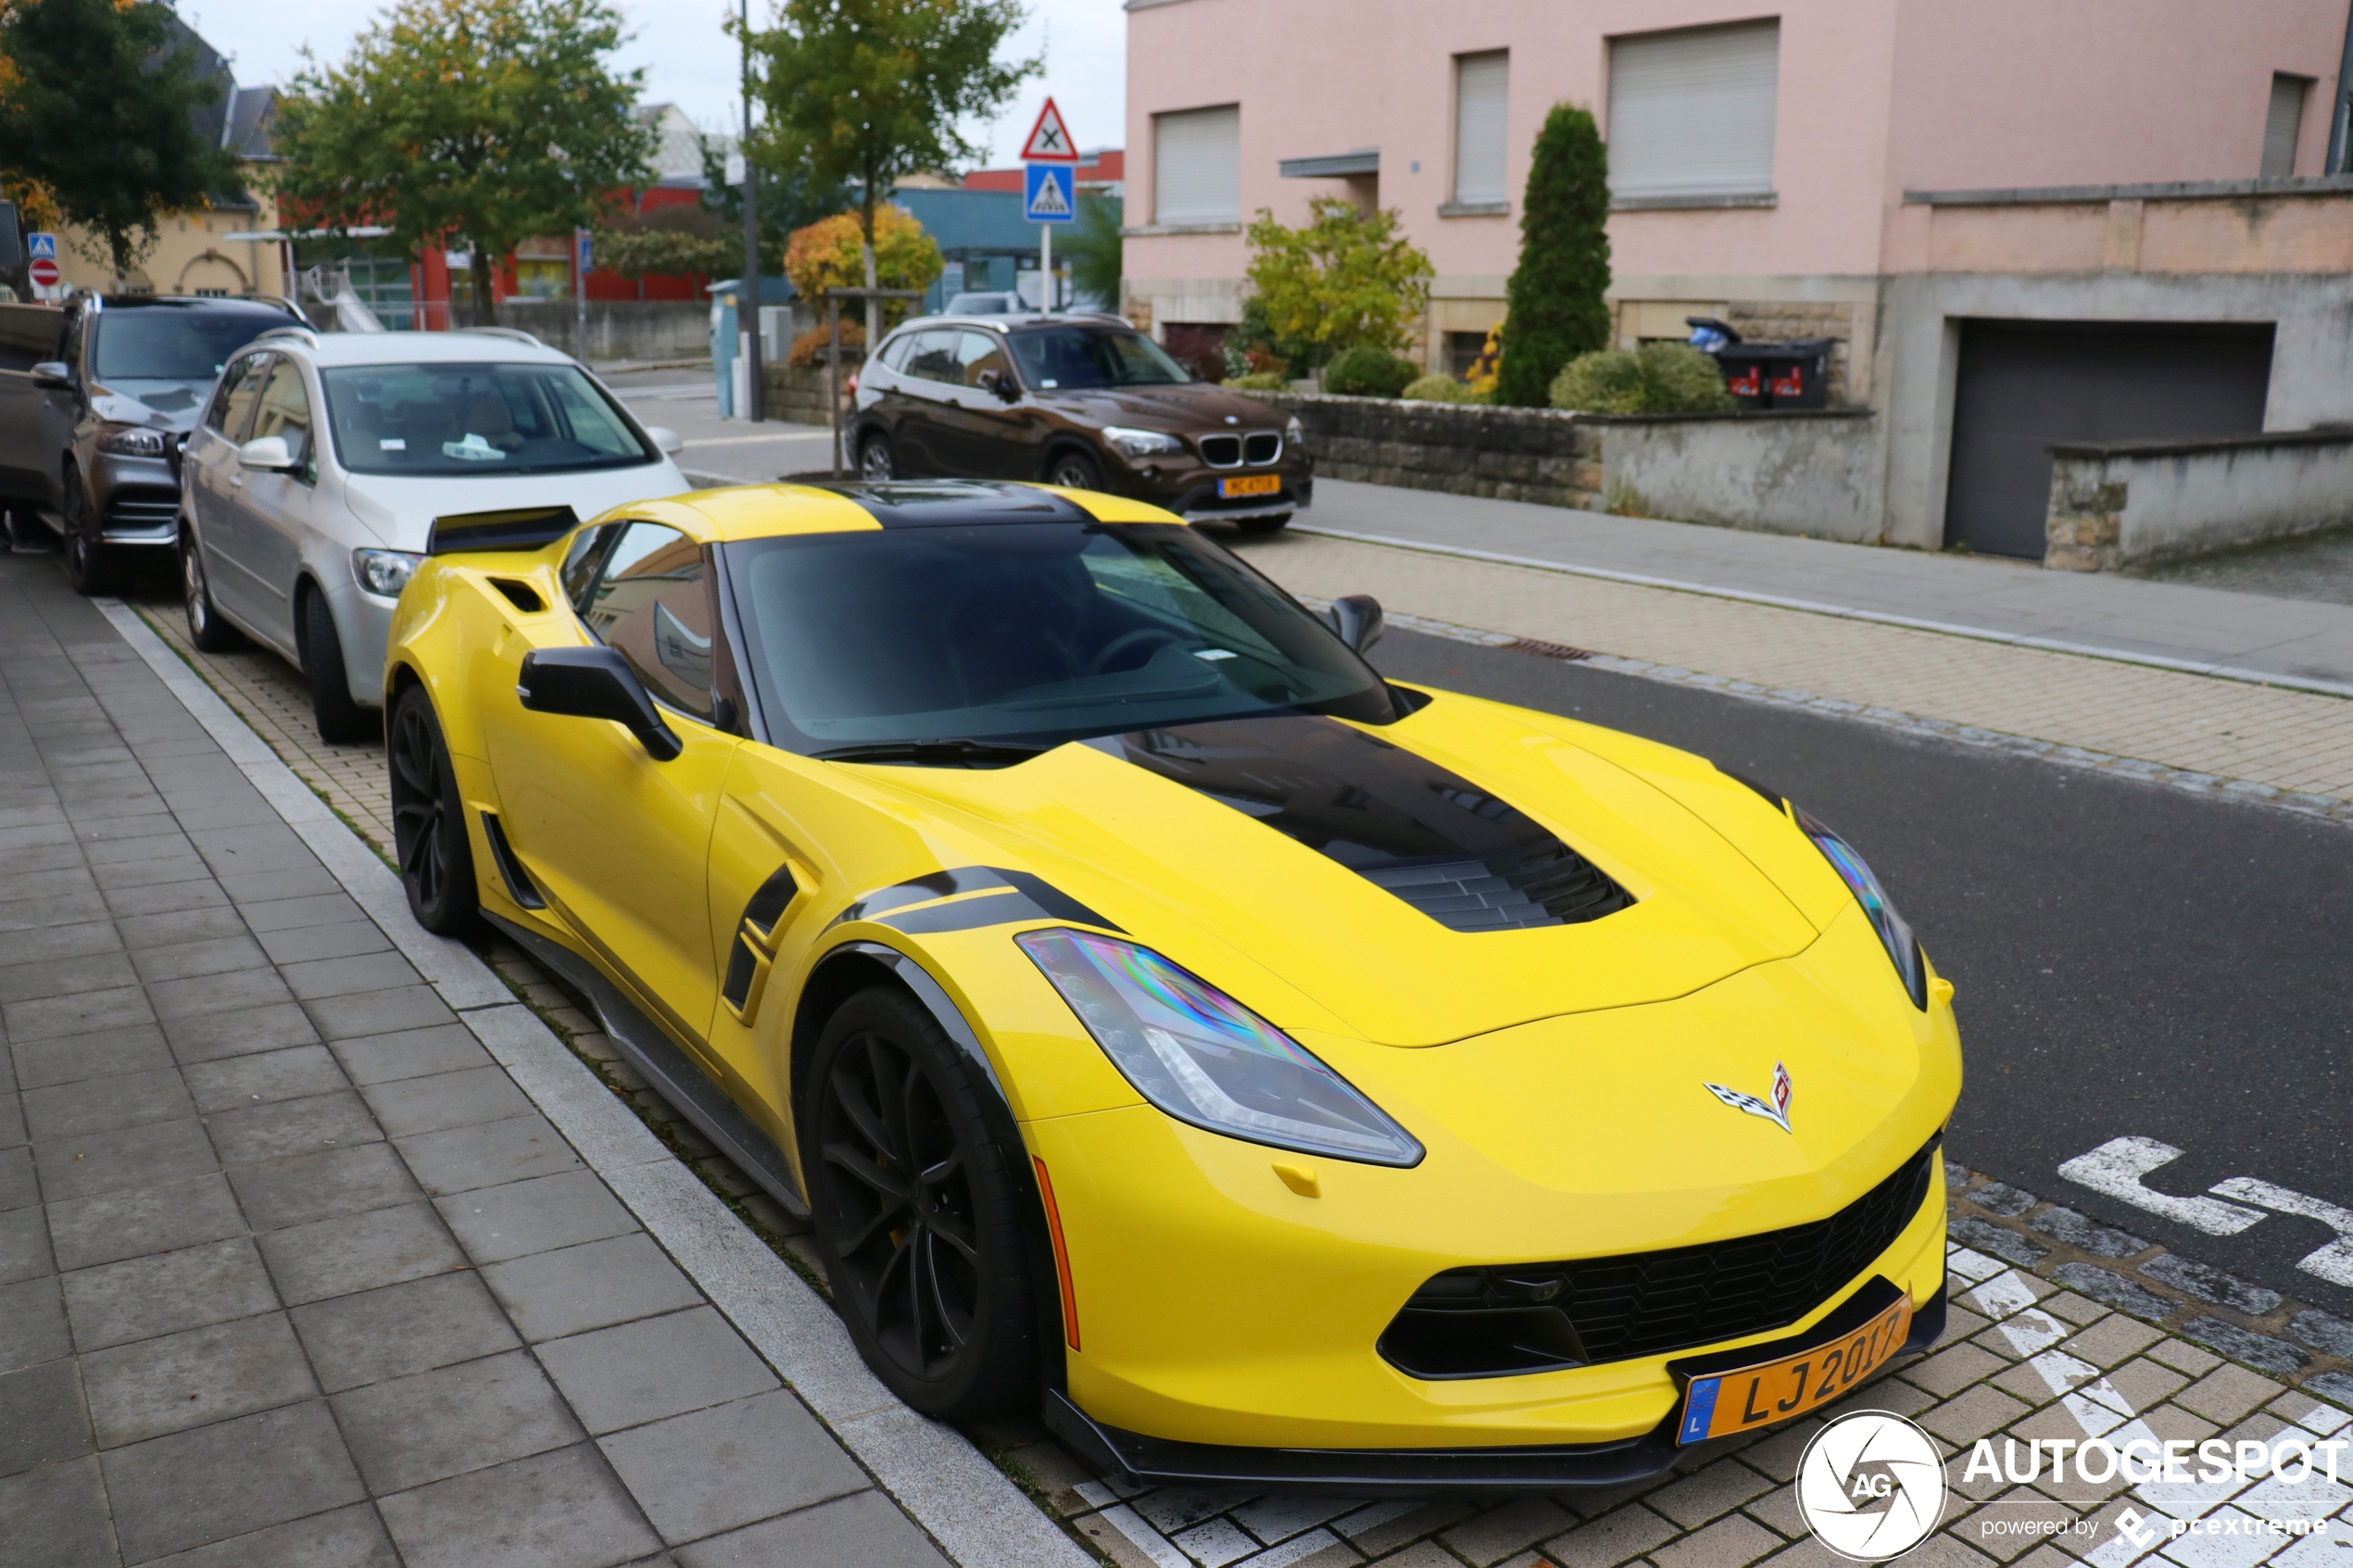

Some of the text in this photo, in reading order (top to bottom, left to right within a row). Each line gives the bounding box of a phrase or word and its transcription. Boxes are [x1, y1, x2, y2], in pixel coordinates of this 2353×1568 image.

[1742, 1309, 1901, 1424] LJ 2017
[1689, 1417, 1700, 1434] L
